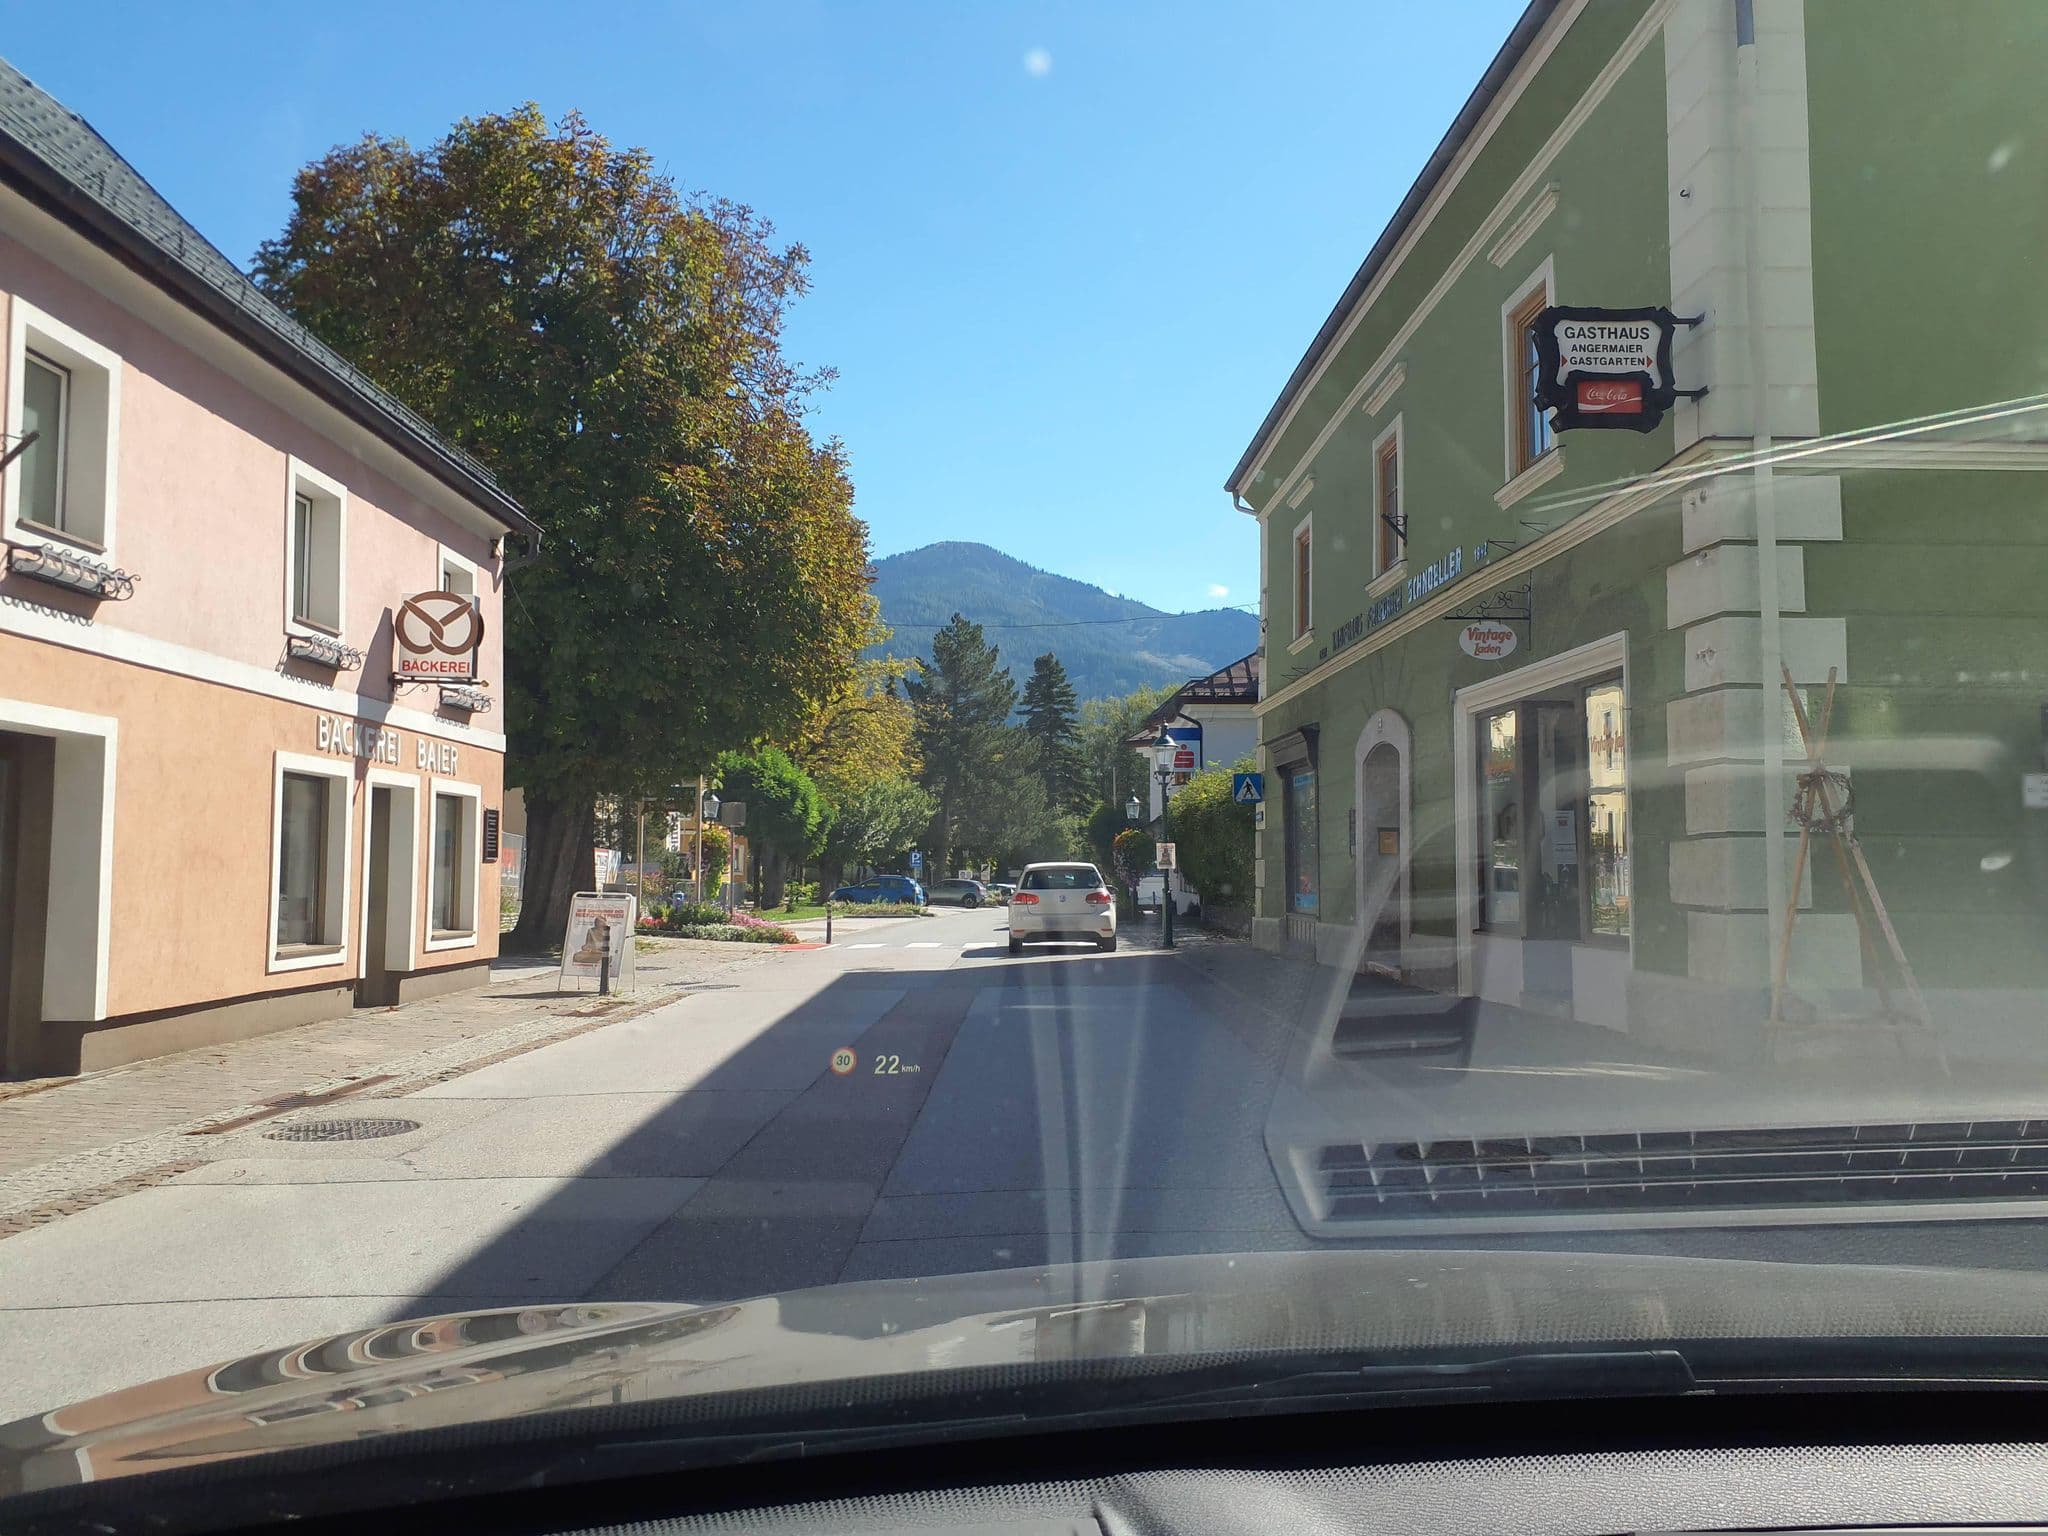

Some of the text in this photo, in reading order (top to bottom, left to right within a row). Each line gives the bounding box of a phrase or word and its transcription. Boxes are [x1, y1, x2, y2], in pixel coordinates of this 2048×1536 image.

[1564, 326, 1650, 340] GASTHAUS
[1571, 343, 1643, 353] ANGERMAIER
[1569, 356, 1645, 366] GASTGARTEN
[1467, 627, 1513, 643] Vintage
[1474, 643, 1501, 656] Laden
[402, 659, 470, 673] BÄCKEREI
[317, 715, 459, 776] BÄCKEREI BAIER
[836, 1055, 850, 1065] 30
[874, 1055, 921, 1074] 22 km/h
